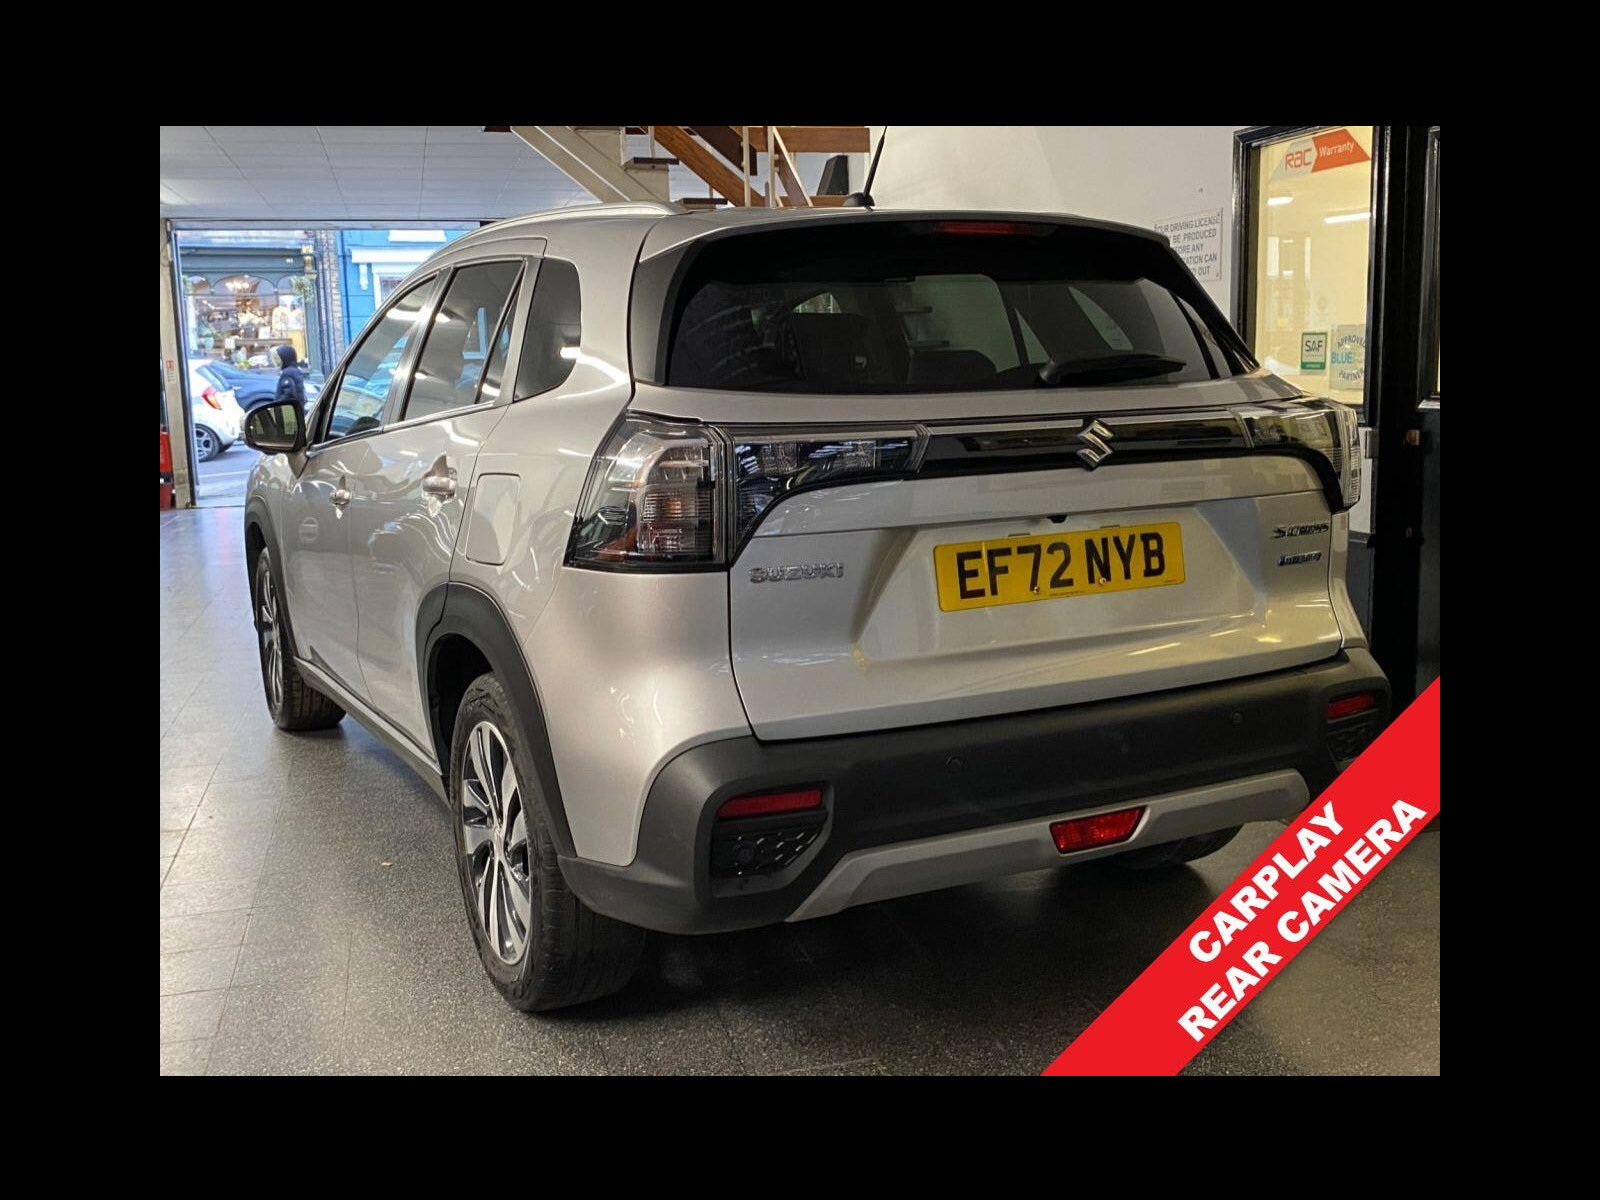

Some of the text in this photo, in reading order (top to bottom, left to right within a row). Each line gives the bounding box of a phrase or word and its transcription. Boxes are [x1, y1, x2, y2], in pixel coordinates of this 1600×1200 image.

[1319, 141, 1355, 157] Warranty
[1170, 220, 1193, 232] DRIVING
[1183, 228, 1217, 241] PRODUCED
[1191, 243, 1204, 252] ANY
[1204, 253, 1218, 263] CAN
[1198, 266, 1211, 275] OUT
[1305, 340, 1323, 352] SAF
[1331, 352, 1353, 364] BLUE
[956, 531, 1166, 600] EF72 NYB
[748, 561, 845, 584] SUZUKI
